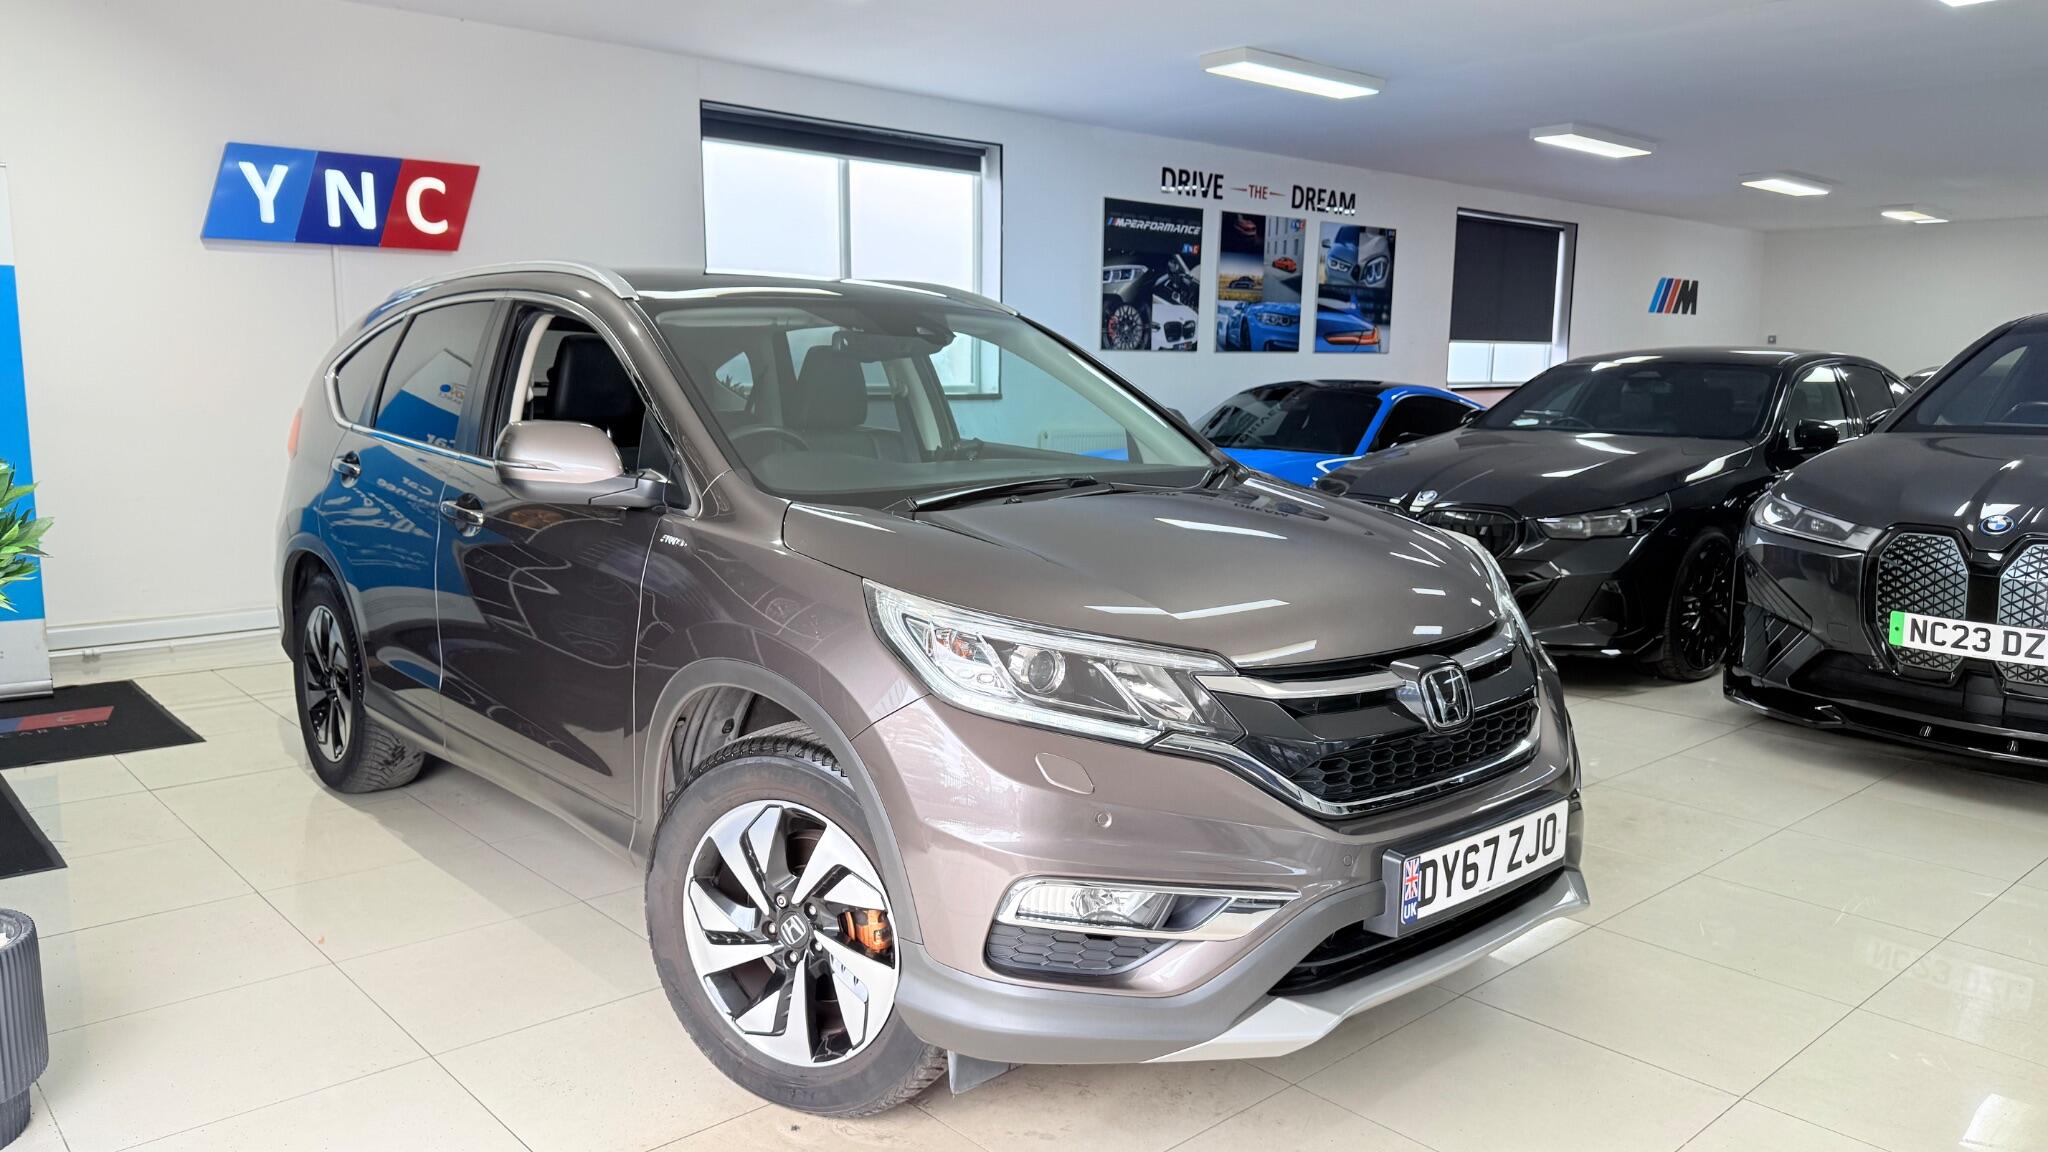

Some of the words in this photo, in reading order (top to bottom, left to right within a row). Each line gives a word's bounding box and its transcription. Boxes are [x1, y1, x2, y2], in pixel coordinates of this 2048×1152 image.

[238, 161, 449, 235] YNC
[1161, 167, 1224, 200] DRIVE
[1249, 184, 1269, 200] THE
[1291, 184, 1356, 216] DREAM
[1909, 617, 1991, 653] NC23
[2001, 630, 2046, 660] DZ
[1417, 834, 1500, 908] DY67
[1404, 902, 1417, 919] UK
